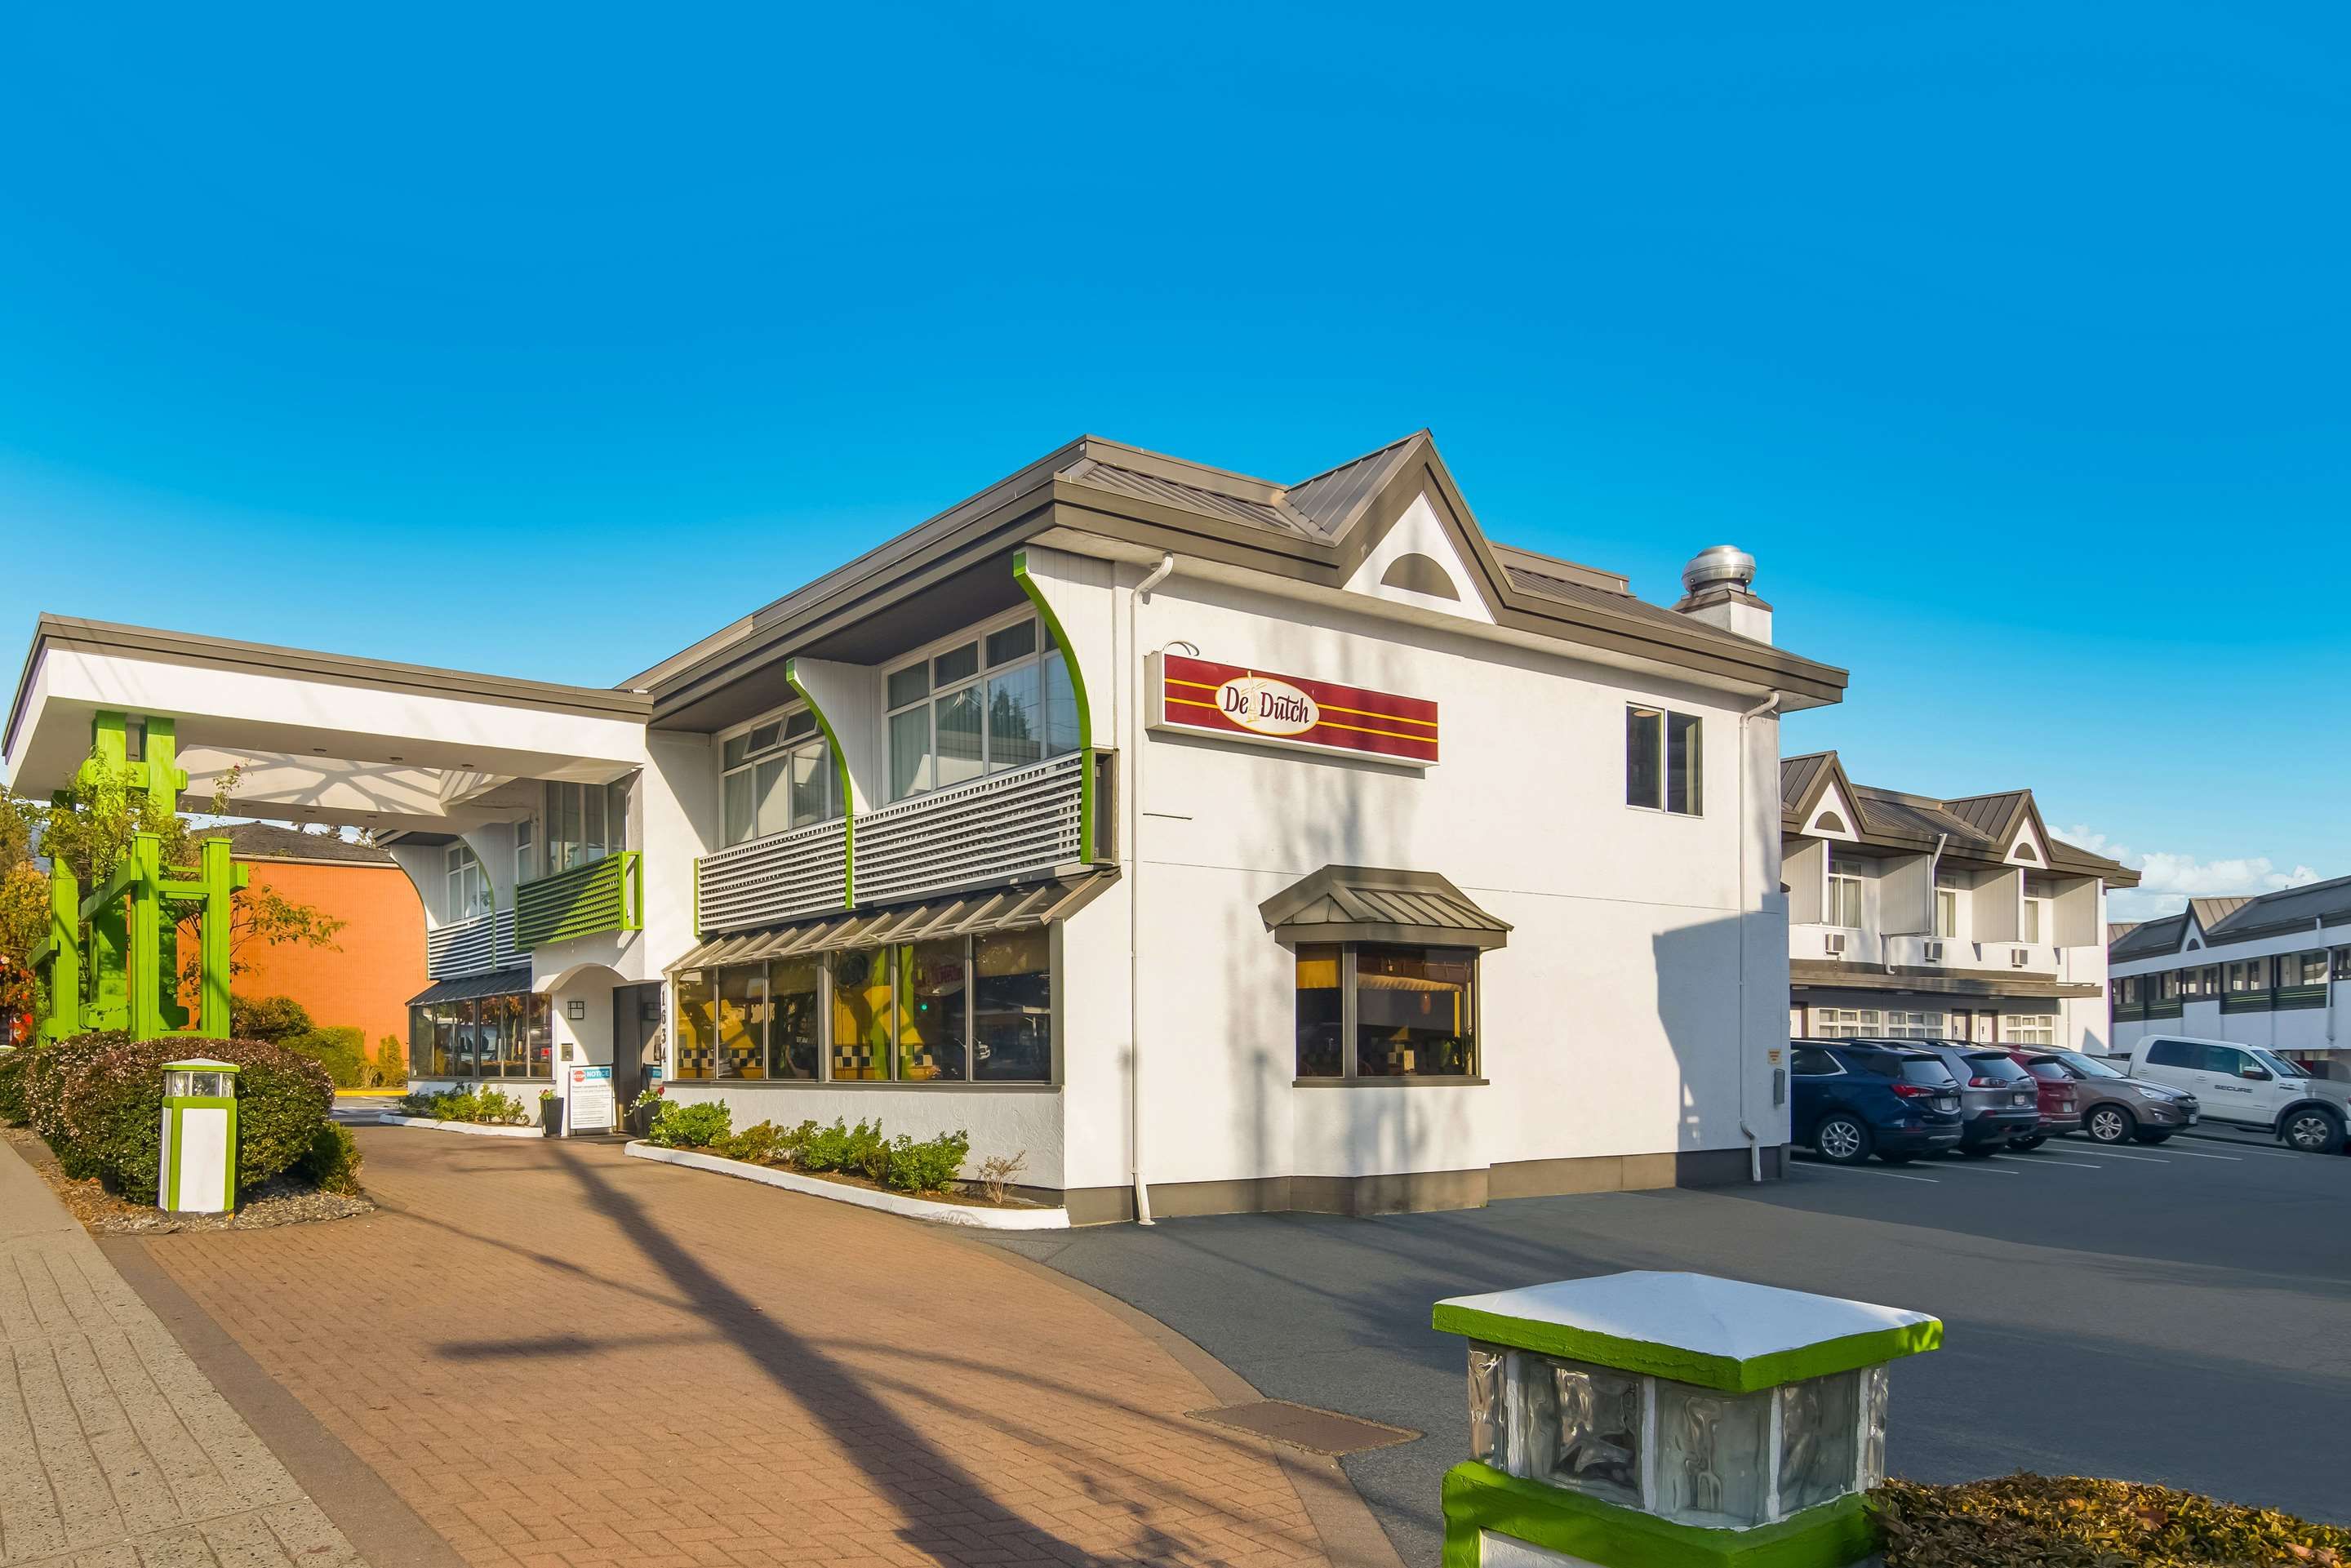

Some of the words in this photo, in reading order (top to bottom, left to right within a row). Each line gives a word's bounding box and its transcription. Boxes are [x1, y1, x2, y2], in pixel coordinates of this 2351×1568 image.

[1224, 686, 1248, 714] De
[1260, 692, 1309, 723] Dutch
[586, 1069, 610, 1077] NOTICE
[2214, 1084, 2253, 1094] SECURE
